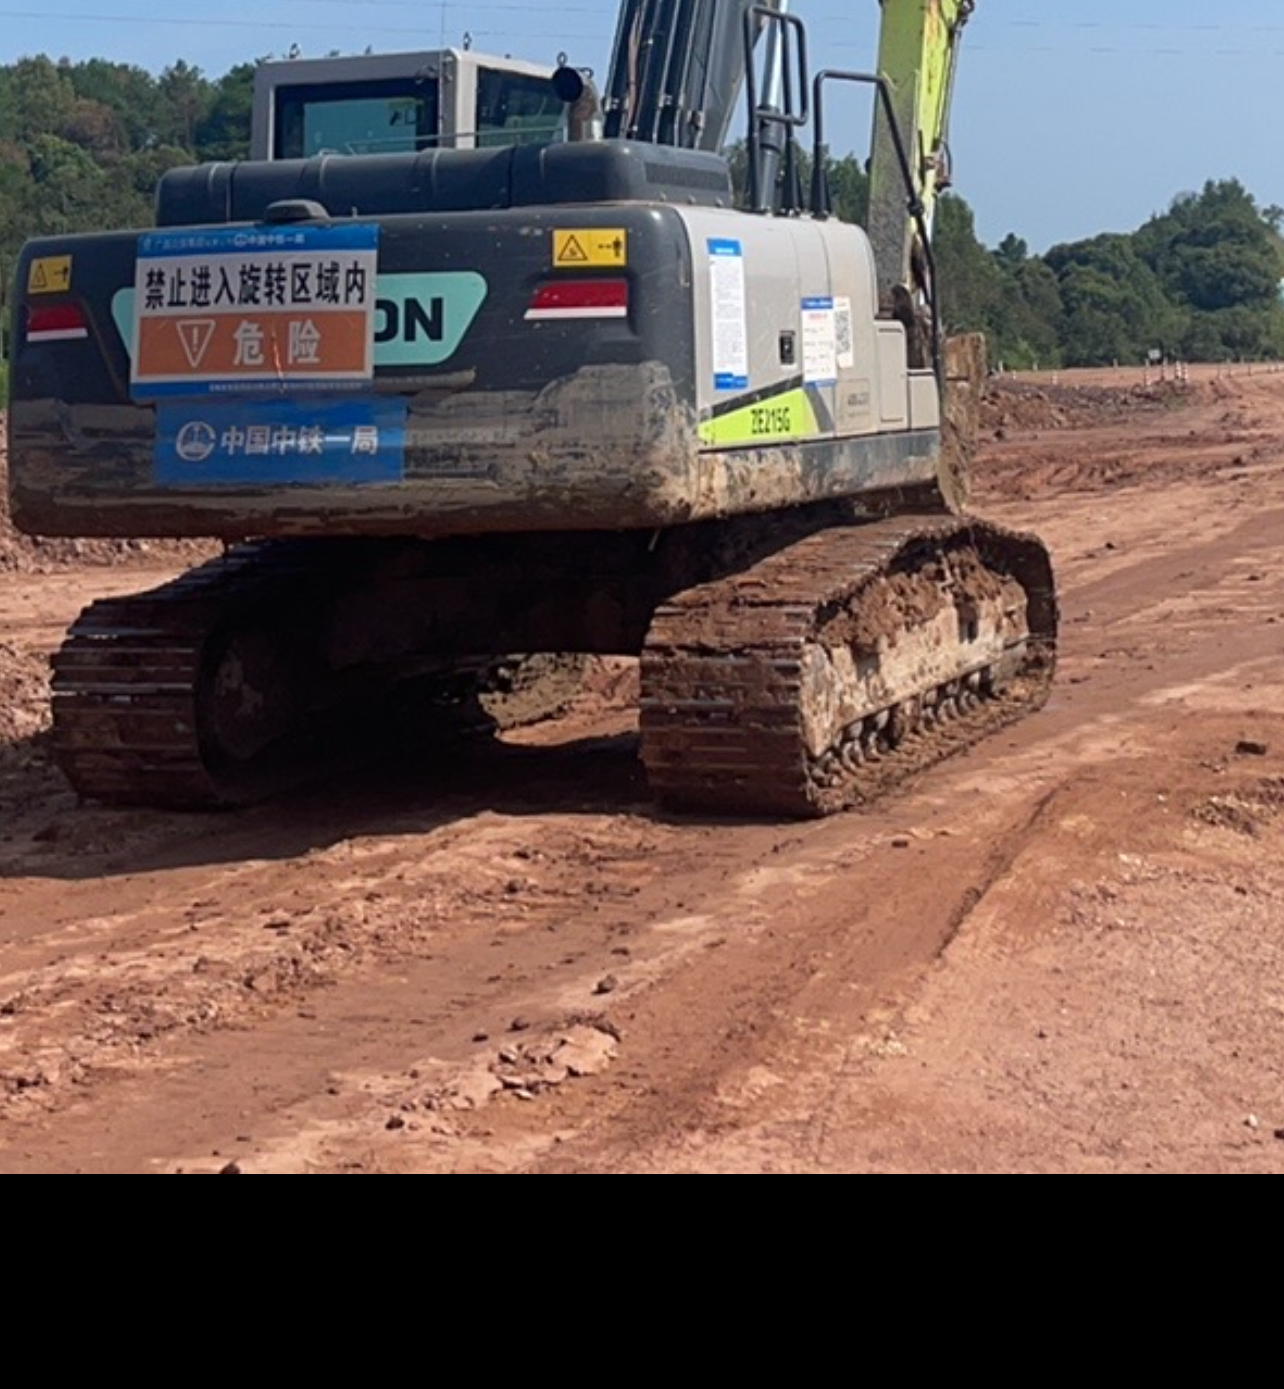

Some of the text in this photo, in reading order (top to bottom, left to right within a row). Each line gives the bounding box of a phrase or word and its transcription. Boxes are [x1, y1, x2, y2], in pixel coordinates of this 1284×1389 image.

[145, 261, 366, 309] 禁止进入旋转区域内
[233, 318, 321, 366] 危险
[221, 425, 378, 455] 中国中铁一局
[751, 407, 790, 434] ZE215G
